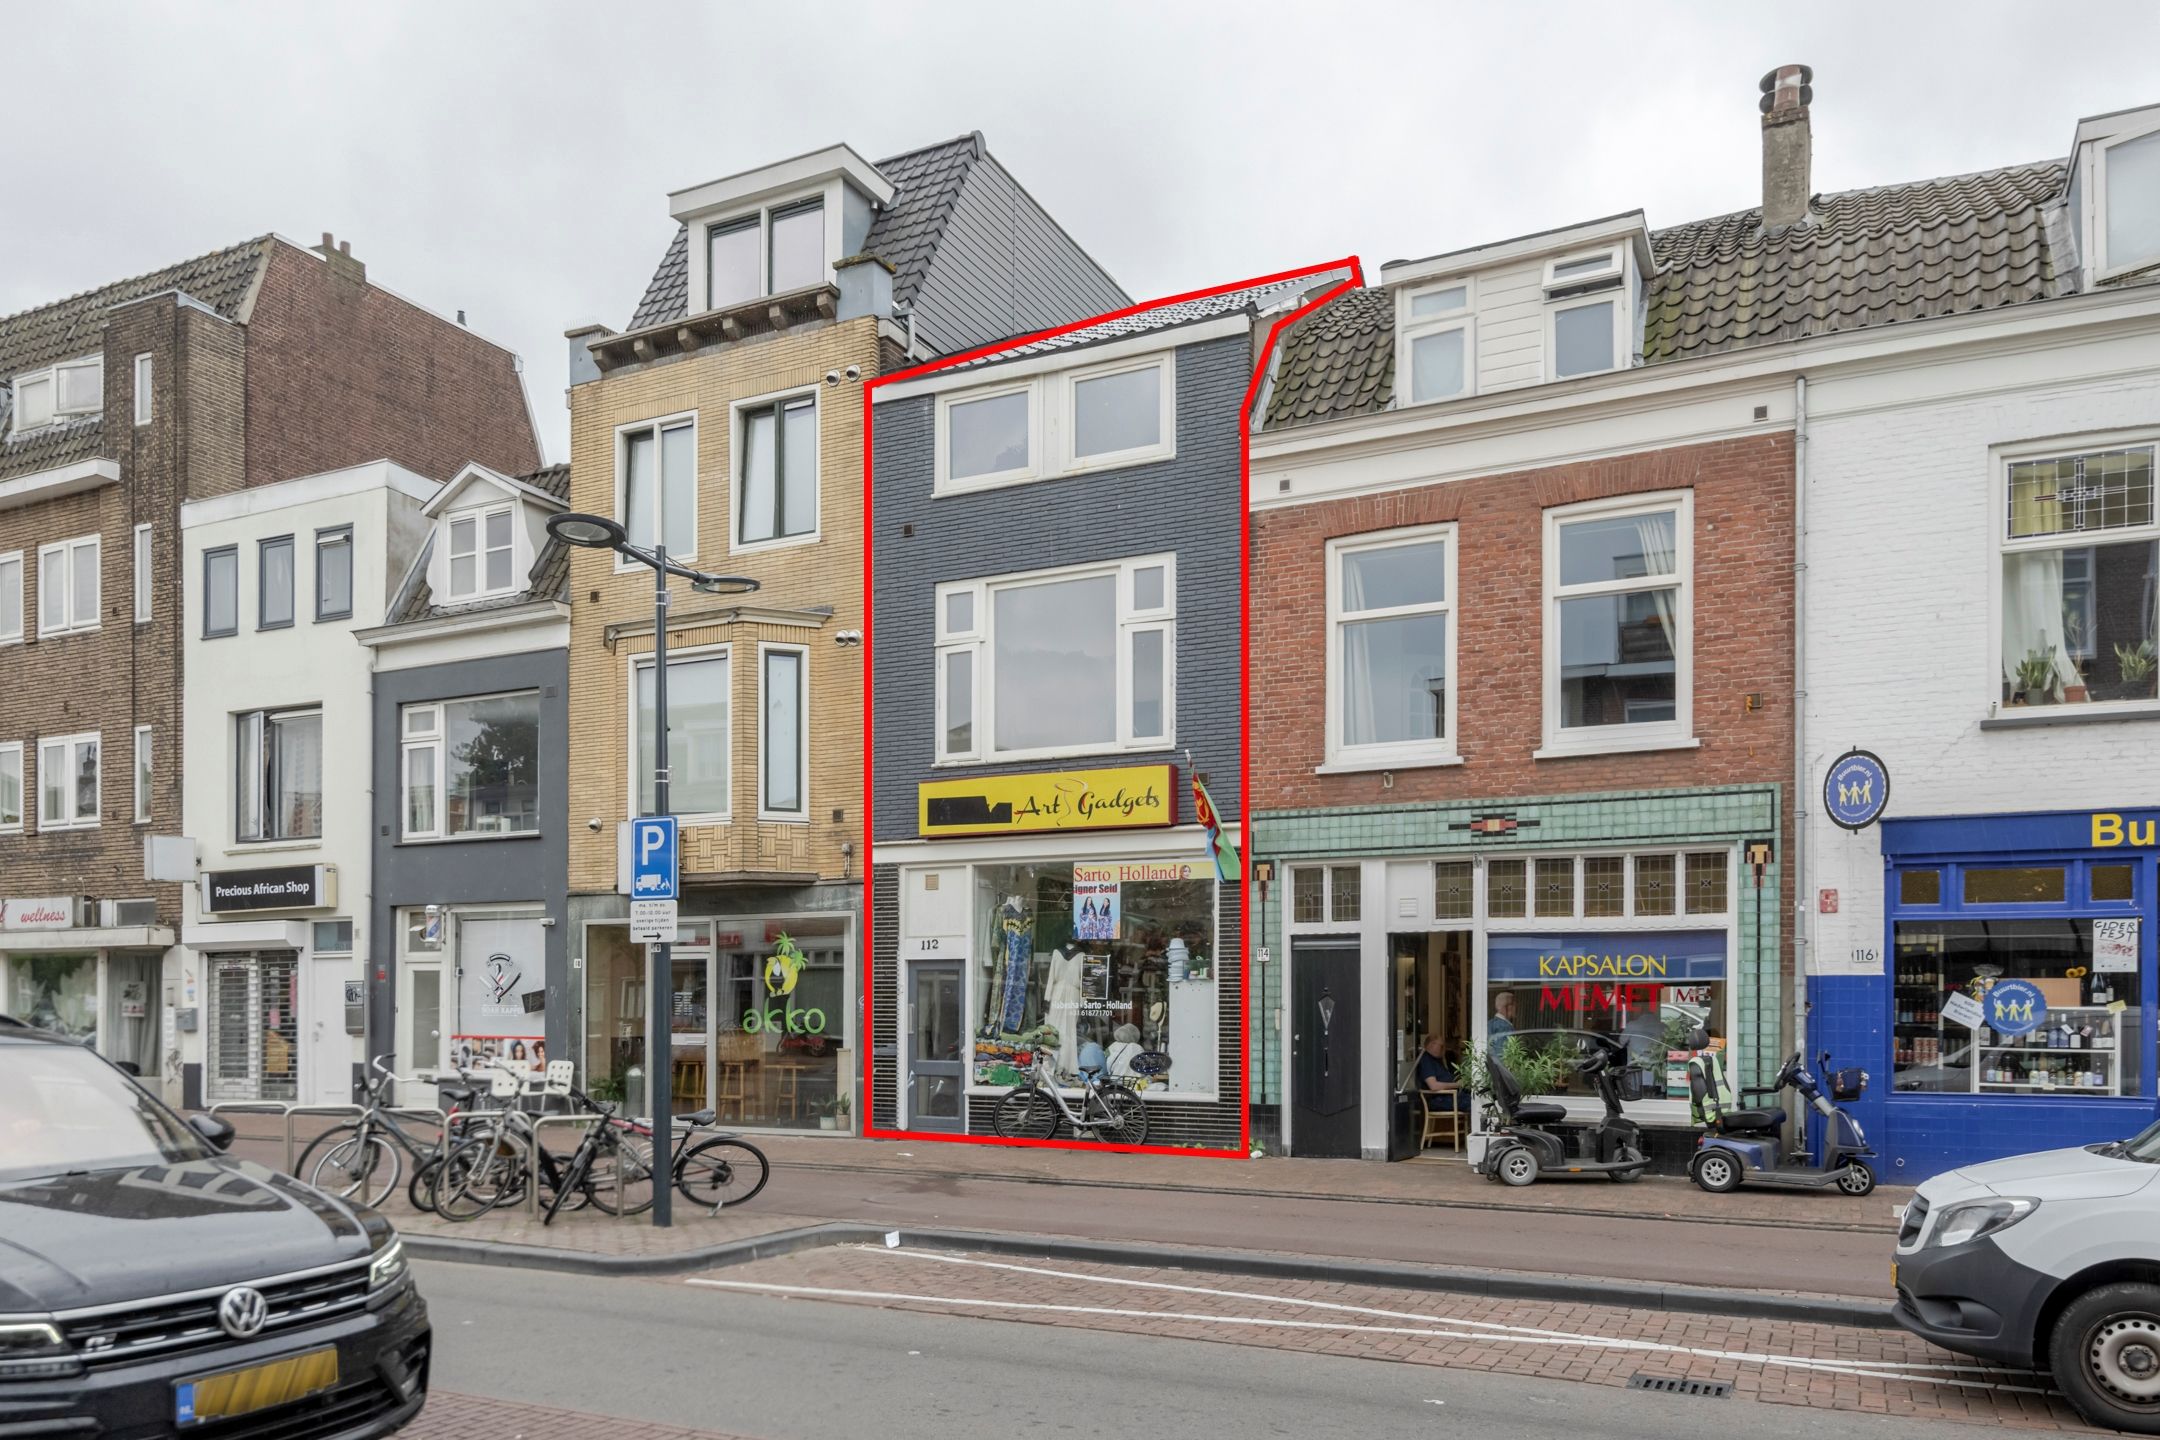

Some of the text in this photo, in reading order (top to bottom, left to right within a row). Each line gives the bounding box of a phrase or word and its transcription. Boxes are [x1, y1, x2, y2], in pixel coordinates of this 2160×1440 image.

[1837, 764, 1873, 781] Buurtbier.nl
[1013, 786, 1160, 824] Art Gadgets
[2091, 813, 2155, 847] Bu
[642, 825, 665, 866] P
[1074, 864, 1177, 882] Sarto Holland
[215, 881, 310, 897] Precious African Shop
[20, 907, 66, 923] wellness
[921, 939, 939, 950] 112
[1257, 948, 1269, 957] 114
[1856, 949, 1874, 961] 116
[1539, 954, 1666, 976] KAPSALON
[1539, 983, 1665, 1013] MEMET
[1991, 984, 2036, 999] Buurtbier.nl
[1083, 1000, 1102, 1010] Sarto
[1106, 1000, 1133, 1010] Holland
[742, 997, 826, 1034] akko
